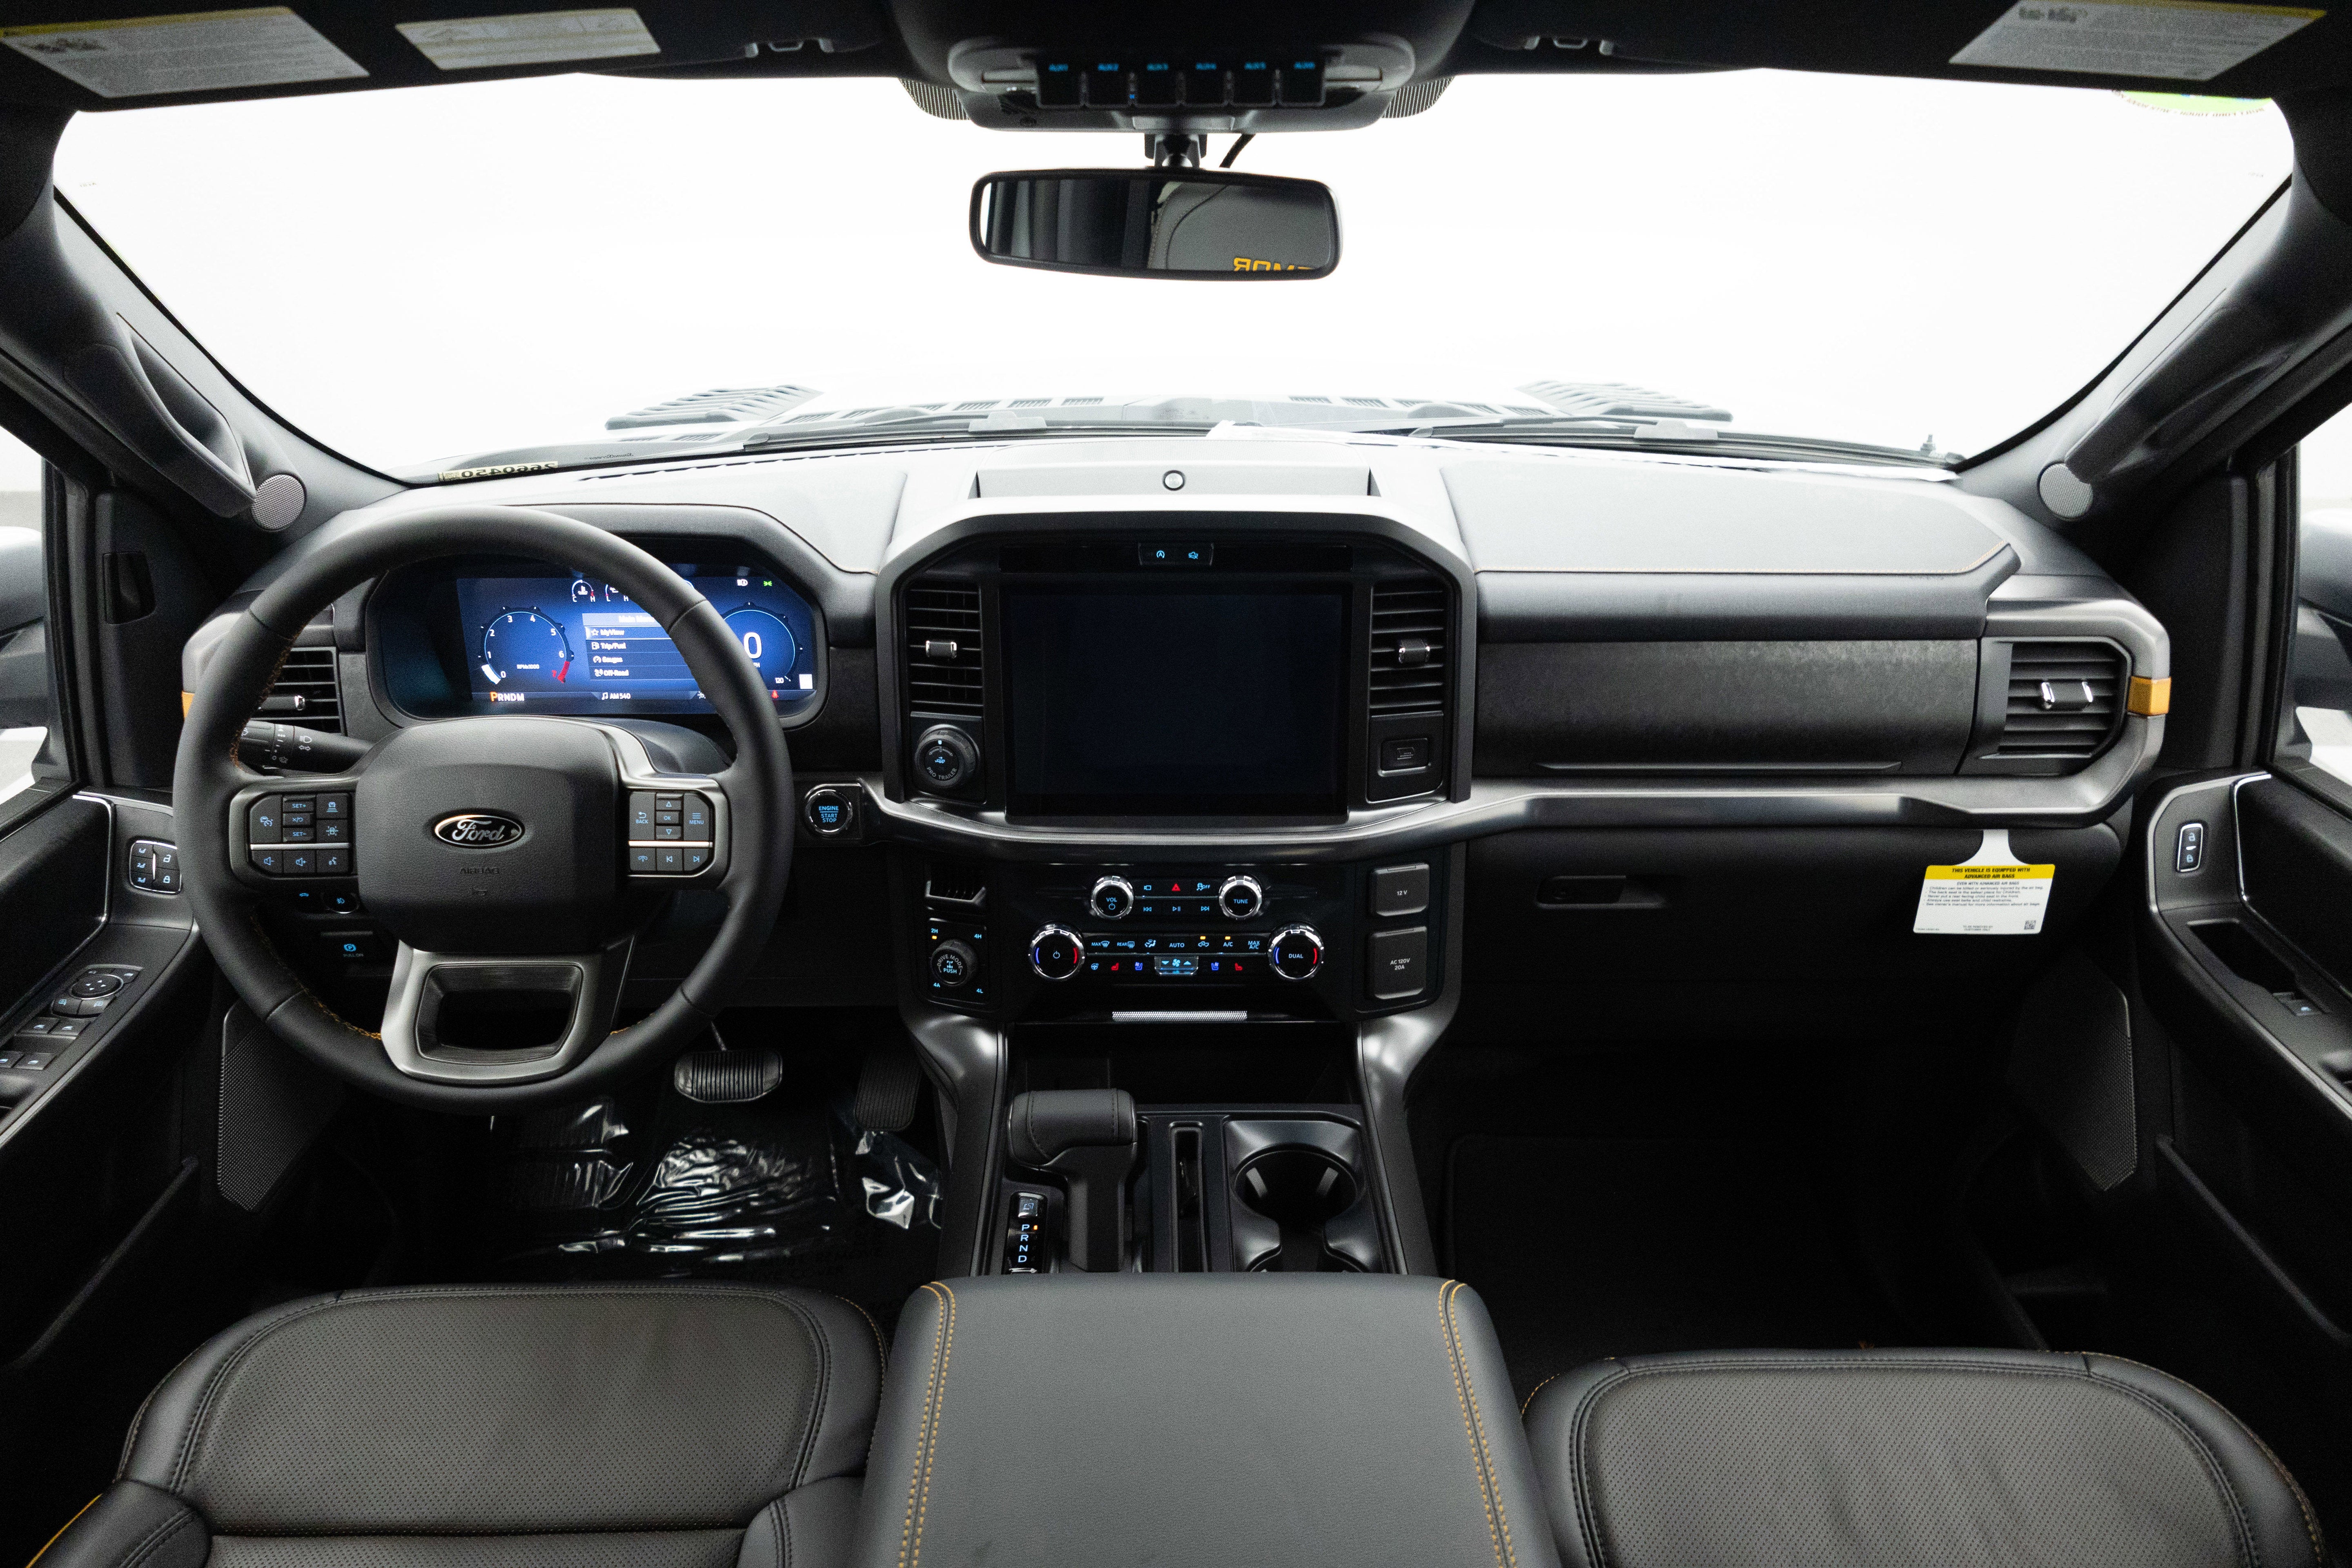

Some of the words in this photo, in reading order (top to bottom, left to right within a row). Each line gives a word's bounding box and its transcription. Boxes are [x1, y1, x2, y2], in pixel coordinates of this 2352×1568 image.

[743, 632, 762, 659] 0
[926, 767, 937, 777] PRO
[938, 768, 958, 780] TRAILER
[452, 819, 506, 841] Ford
[937, 954, 949, 967] DRIVE
[950, 954, 963, 969] MODE
